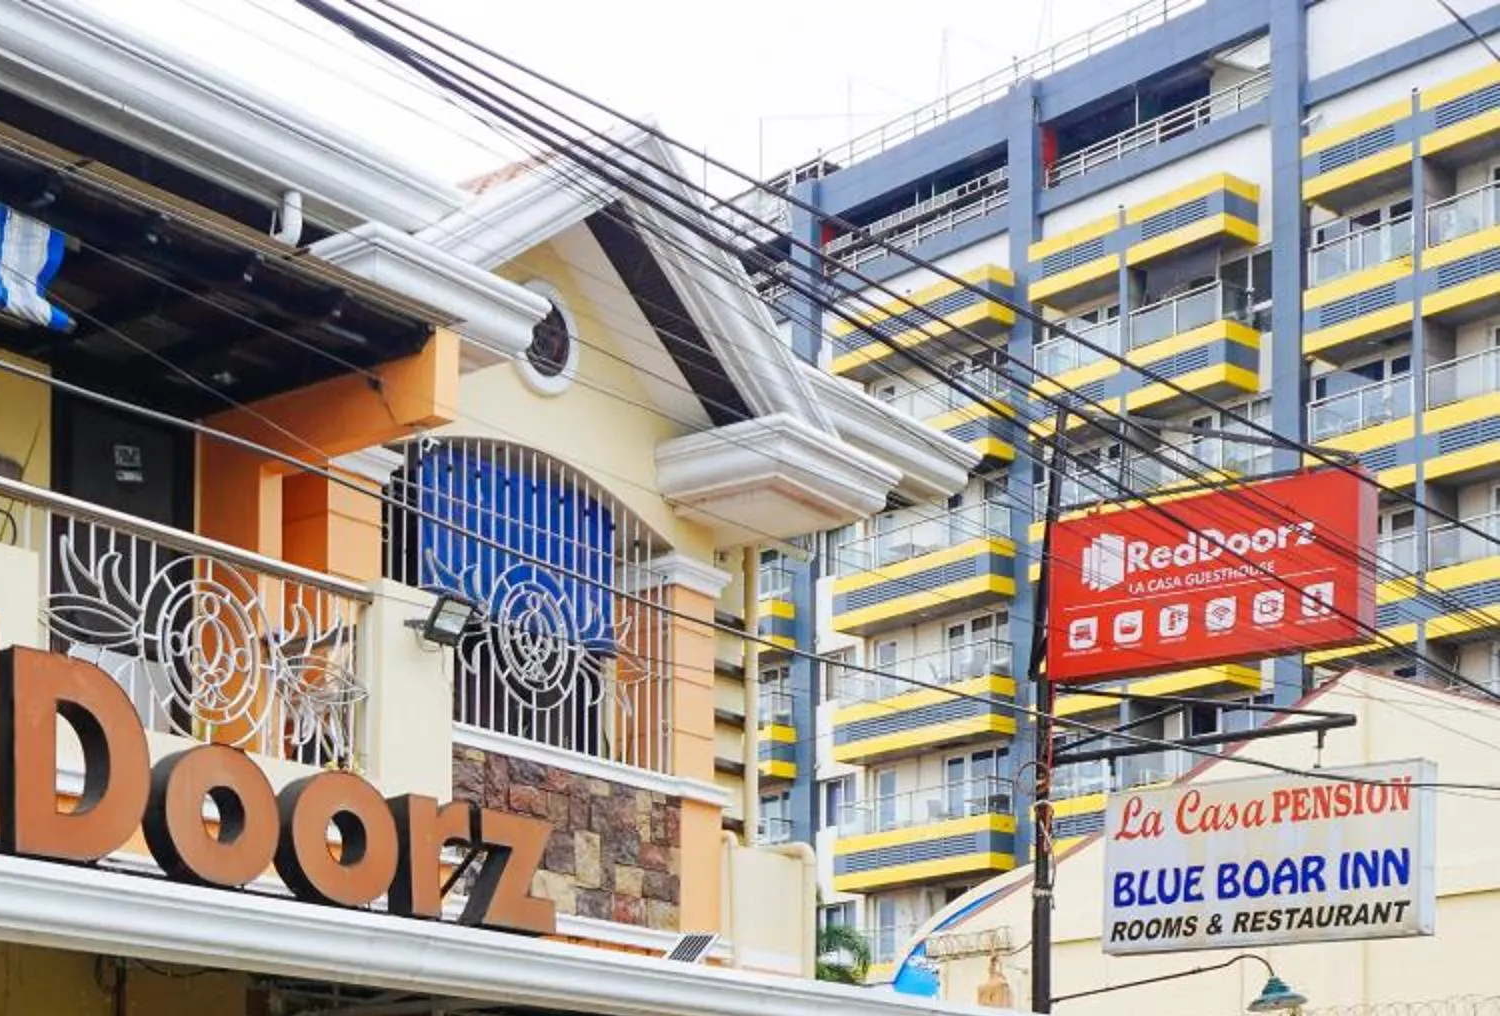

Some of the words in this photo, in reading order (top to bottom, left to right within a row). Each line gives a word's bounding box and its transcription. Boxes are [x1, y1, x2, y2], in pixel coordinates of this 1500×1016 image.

[1127, 521, 1316, 573] RedDoorz
[1129, 581, 1145, 594] LA
[1147, 577, 1181, 592] CASA
[1185, 561, 1275, 586] GUESTHOUSE
[1114, 796, 1165, 840] La
[1175, 789, 1266, 835] Casa
[1271, 776, 1412, 824] PENSION
[1113, 866, 1205, 908] BLUE
[1217, 855, 1326, 899] BOAR
[1339, 847, 1410, 891] INN
[1110, 917, 1197, 942] ROOMS
[1205, 914, 1224, 934] &
[1232, 901, 1411, 933] RESTAURANT
